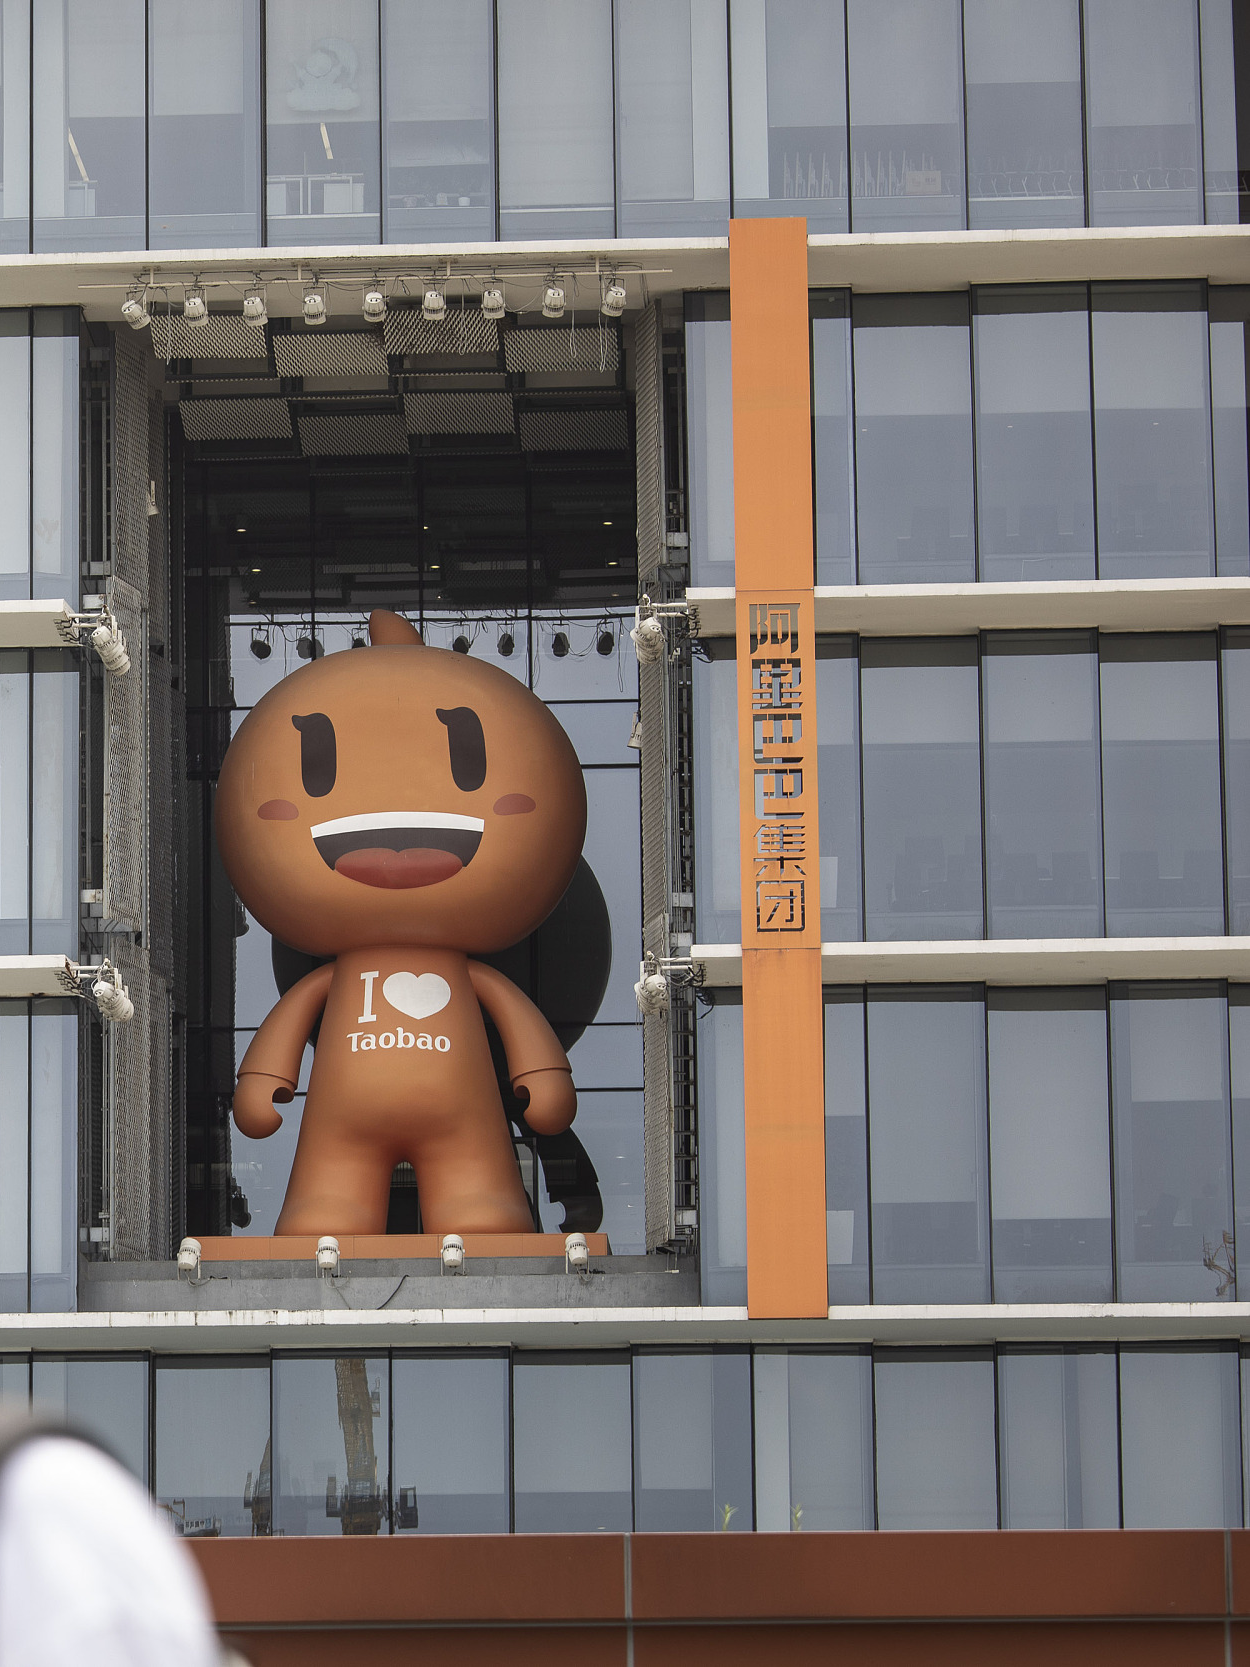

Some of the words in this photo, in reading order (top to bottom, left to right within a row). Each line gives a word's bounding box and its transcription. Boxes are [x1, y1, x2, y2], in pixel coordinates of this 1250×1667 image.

[749, 602, 806, 932] 阿里巴巴集团
[358, 971, 379, 1023] I
[347, 1027, 451, 1052] Taobao
